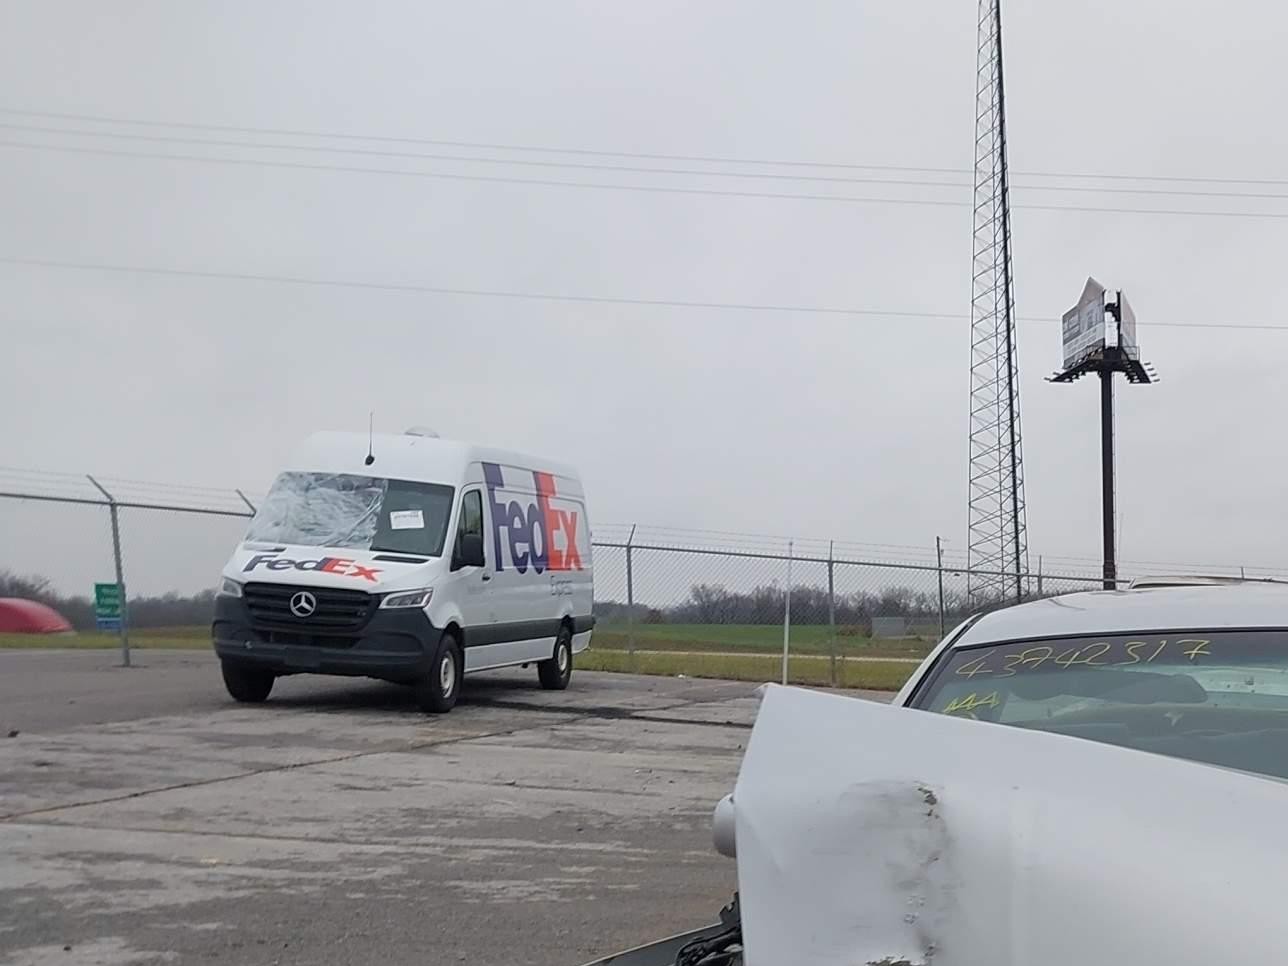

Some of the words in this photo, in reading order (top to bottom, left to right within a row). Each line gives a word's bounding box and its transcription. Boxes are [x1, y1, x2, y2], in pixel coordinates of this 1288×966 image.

[481, 462, 583, 574] FedEx
[243, 554, 384, 582] FedEx
[955, 640, 1212, 679] 43742317
